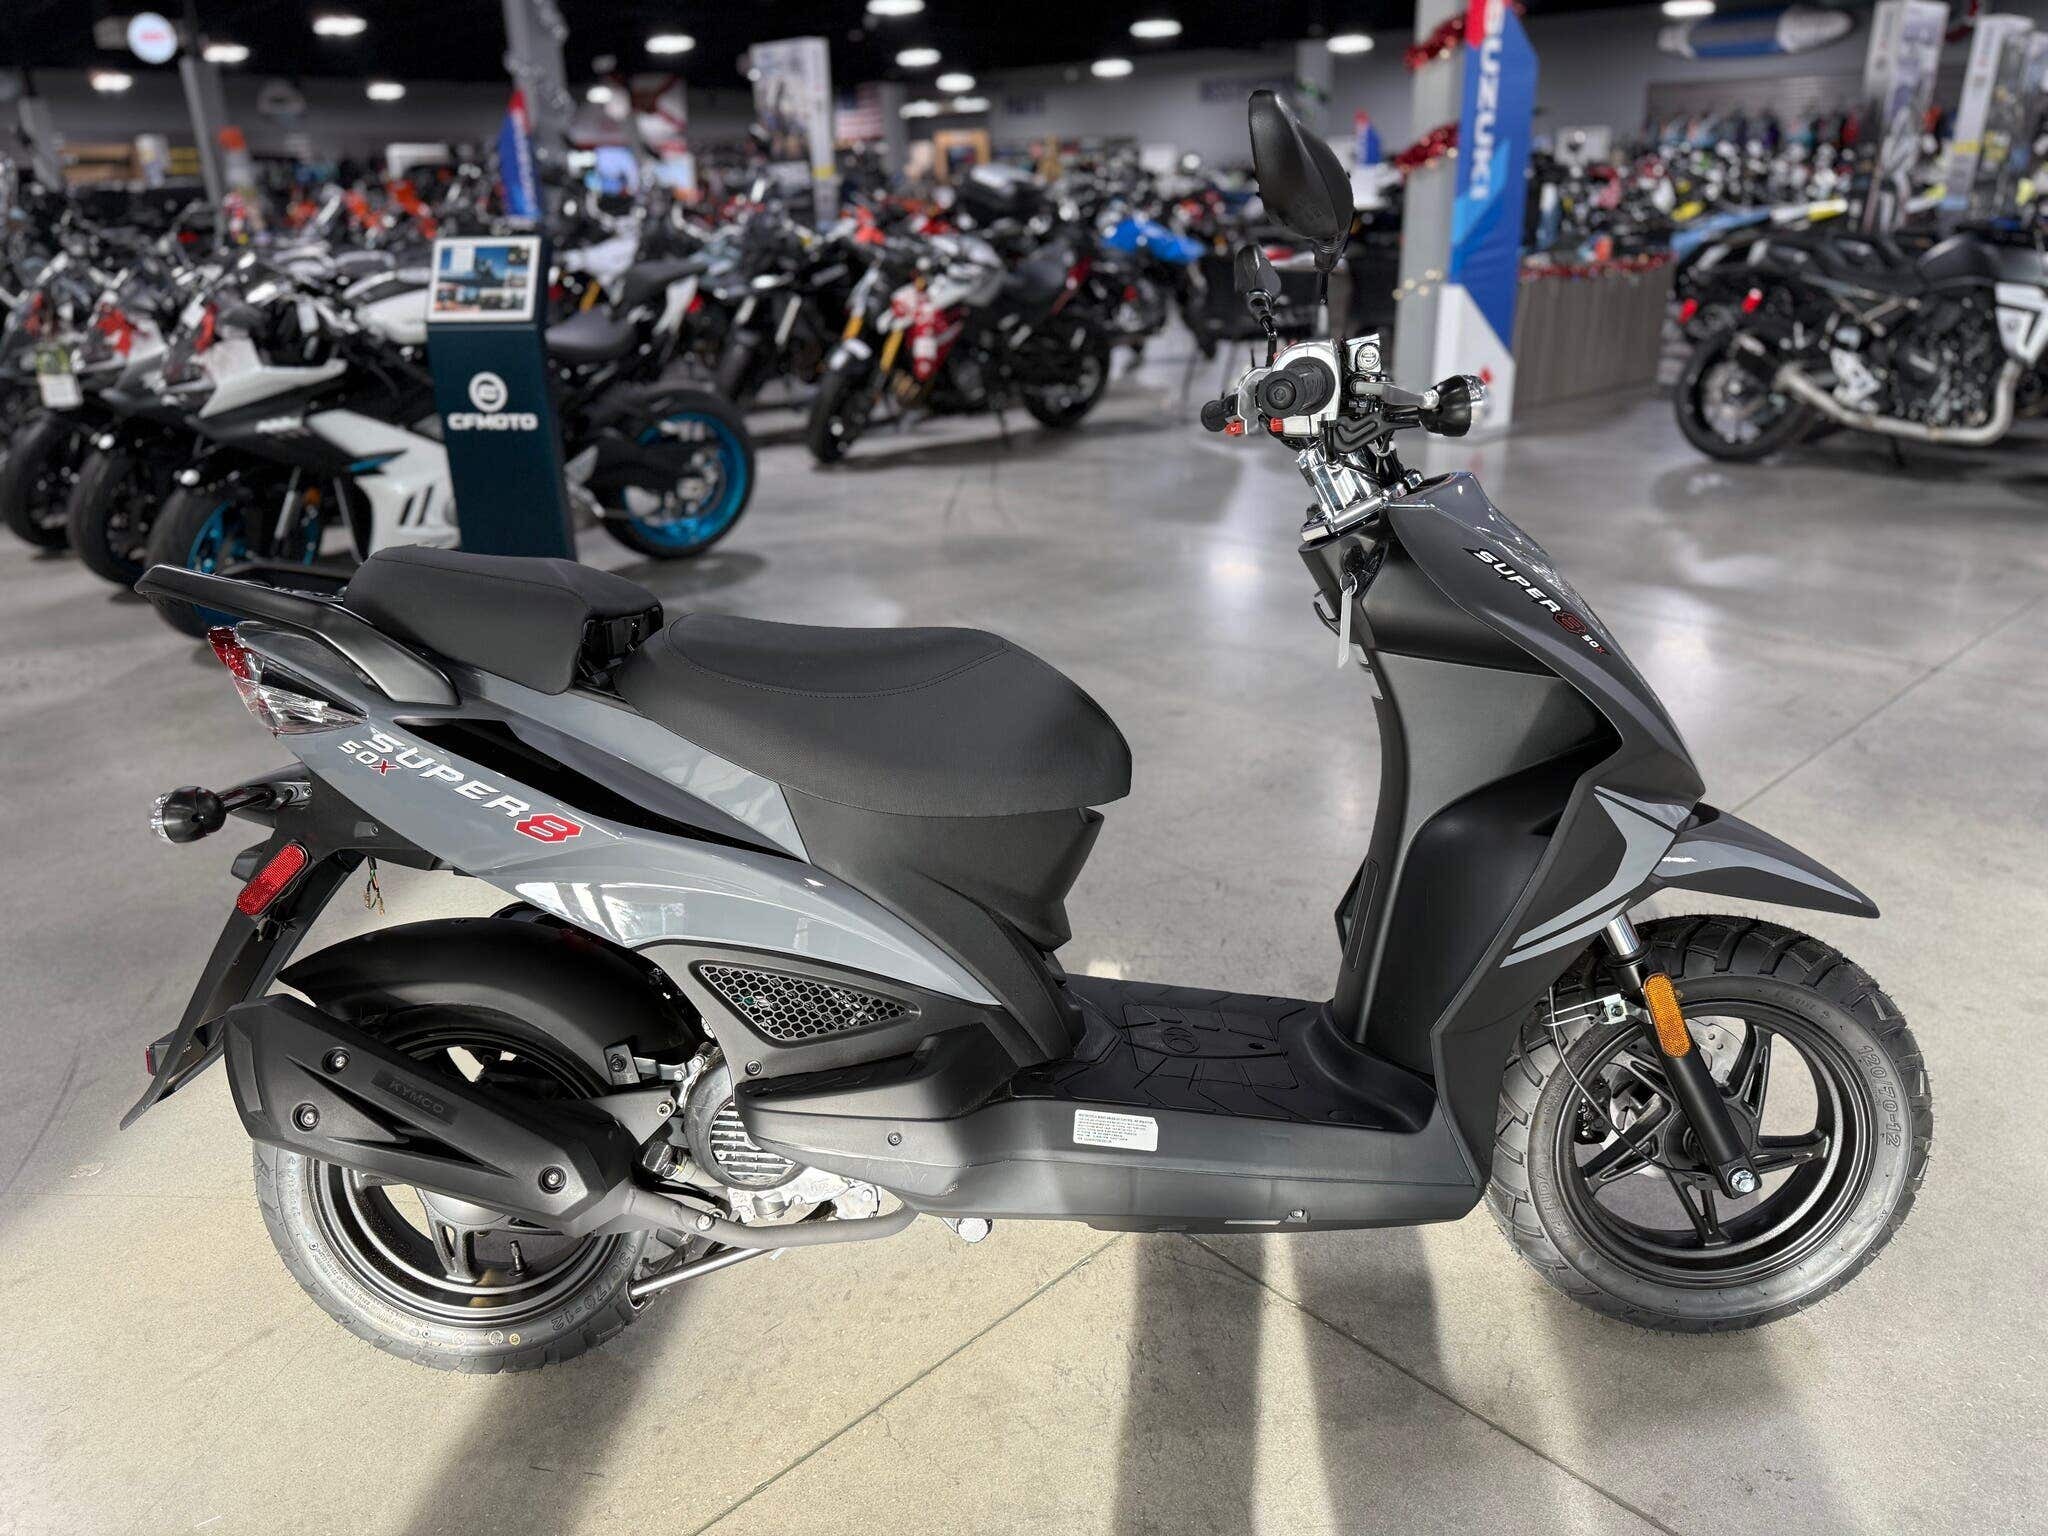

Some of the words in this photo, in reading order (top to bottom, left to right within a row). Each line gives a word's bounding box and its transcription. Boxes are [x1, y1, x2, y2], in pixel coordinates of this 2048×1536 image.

[1469, 0, 1505, 200] SUZUKI
[447, 412, 538, 431] CFMOTO
[1470, 549, 1562, 613] SUPER
[339, 740, 400, 775] 50X
[361, 727, 531, 818] SUPER
[388, 1079, 445, 1114] KYMCO
[1858, 1045, 1902, 1148] 120/70-12
